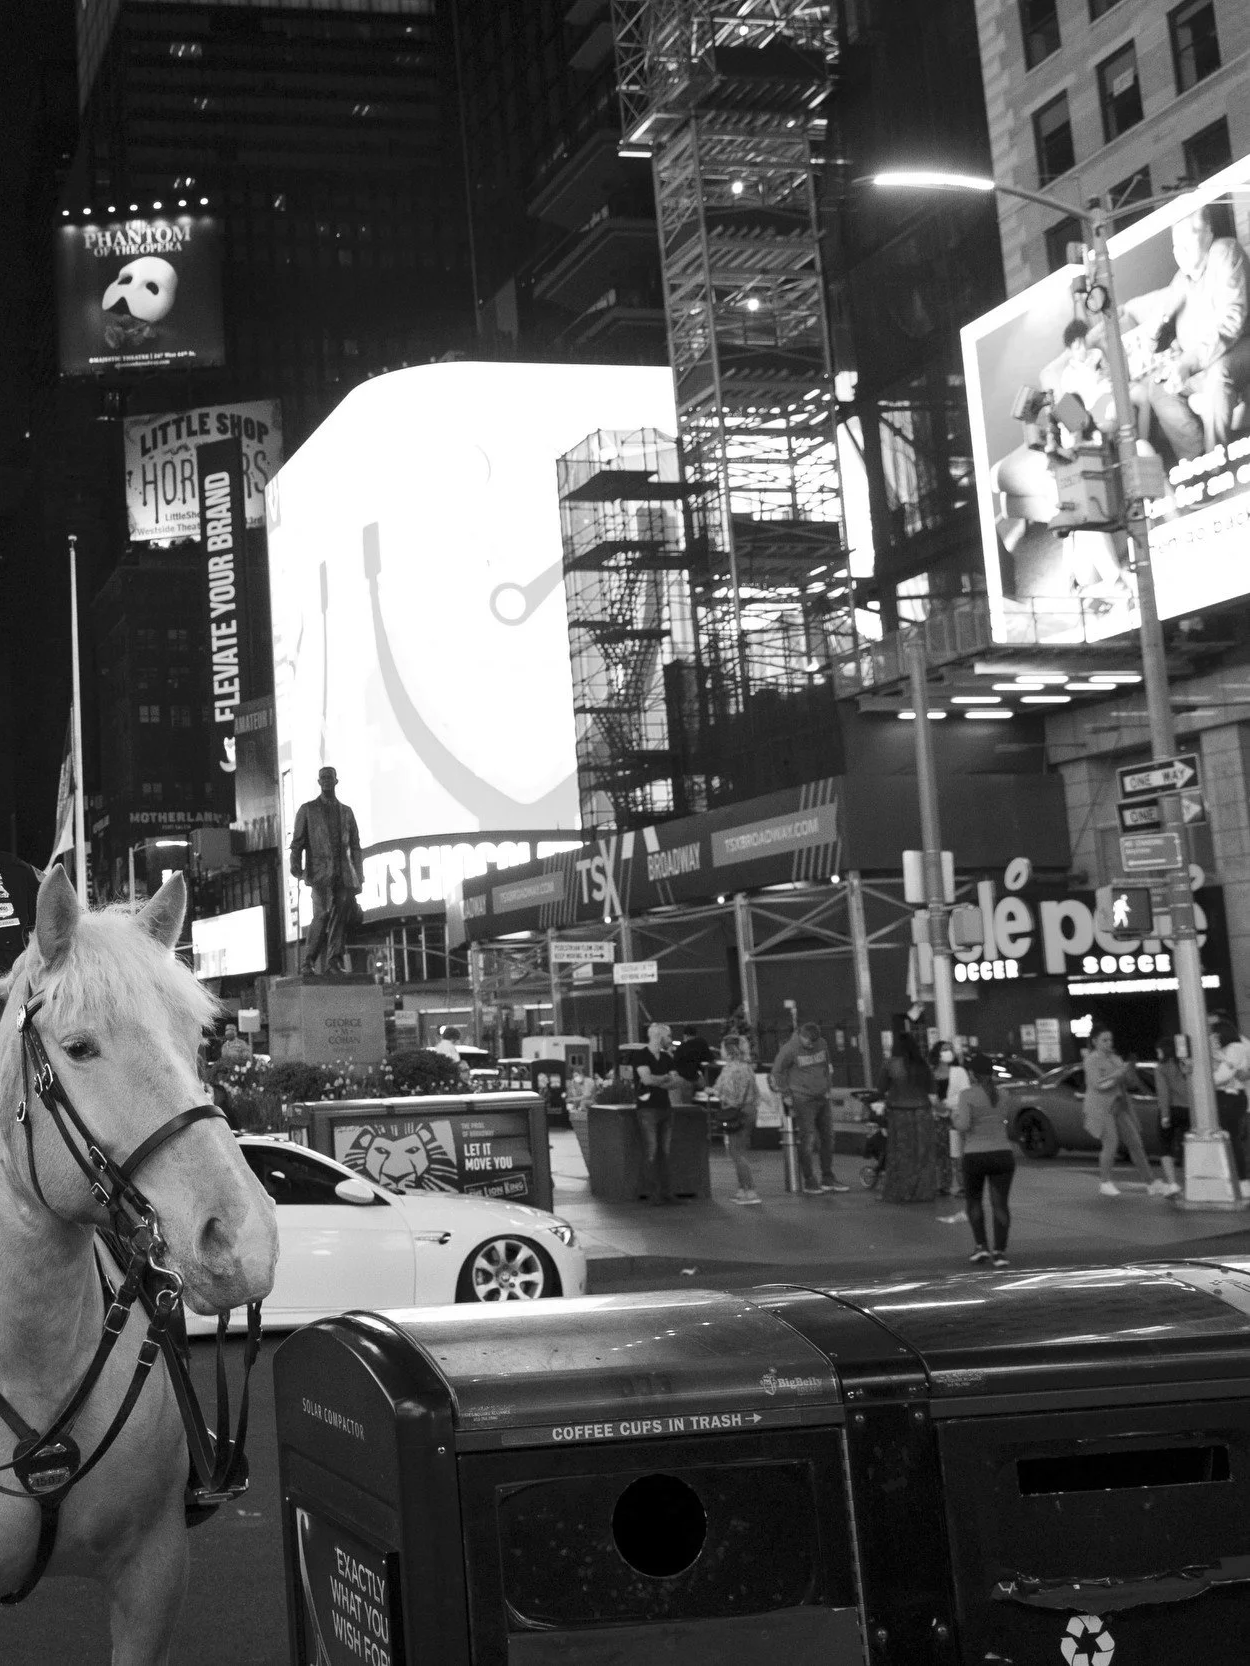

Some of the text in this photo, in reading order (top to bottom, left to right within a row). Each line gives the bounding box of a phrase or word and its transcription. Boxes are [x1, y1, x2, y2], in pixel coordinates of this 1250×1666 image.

[83, 225, 191, 249] PHANTOM
[93, 246, 110, 258] OF
[140, 241, 183, 254] OPERA
[141, 411, 269, 457] LITTLE SHOP
[204, 471, 233, 552] BRAND
[208, 553, 236, 618] YOUR
[1129, 769, 1185, 789] ONE WAY
[575, 835, 701, 917] TSX BROADWAY
[953, 959, 1018, 983] OCCER
[1082, 954, 1171, 974] SOCCE
[464, 1142, 492, 1157] LET IT
[465, 1156, 513, 1171] MOVE YOU
[777, 1377, 823, 1389] BigBelly
[302, 1397, 365, 1441] SOLAR COMPACTOR
[552, 1413, 742, 1441] COFFEE CUPS IN TRASH
[330, 1575, 389, 1644] WHAT YOU
[332, 1610, 362, 1658] WISH
